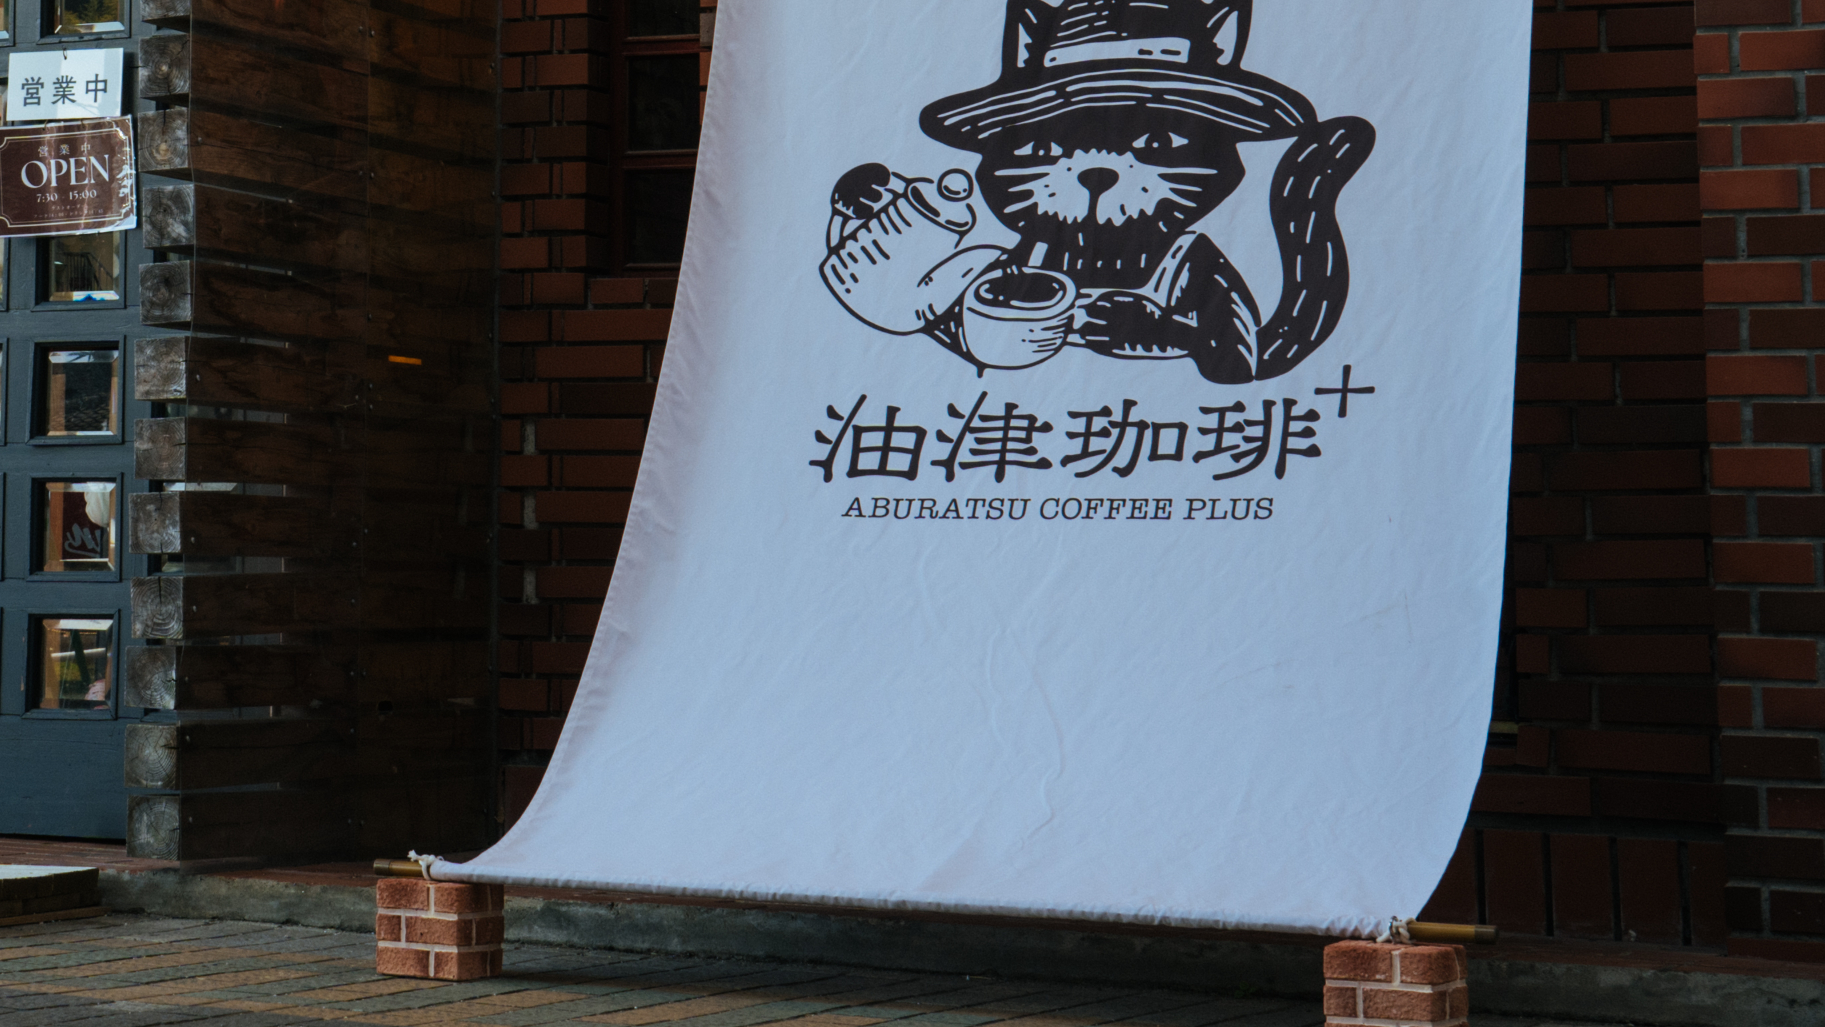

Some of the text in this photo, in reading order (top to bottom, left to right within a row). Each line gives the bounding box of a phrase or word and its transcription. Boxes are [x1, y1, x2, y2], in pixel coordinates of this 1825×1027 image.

[21, 73, 108, 107] 営業中
[38, 142, 91, 157] 営業中
[21, 154, 110, 189] OPEN
[36, 193, 58, 204] 7:30
[69, 189, 97, 201] 15:00
[841, 497, 1274, 521] ABURATSU COFFEE PLUS
